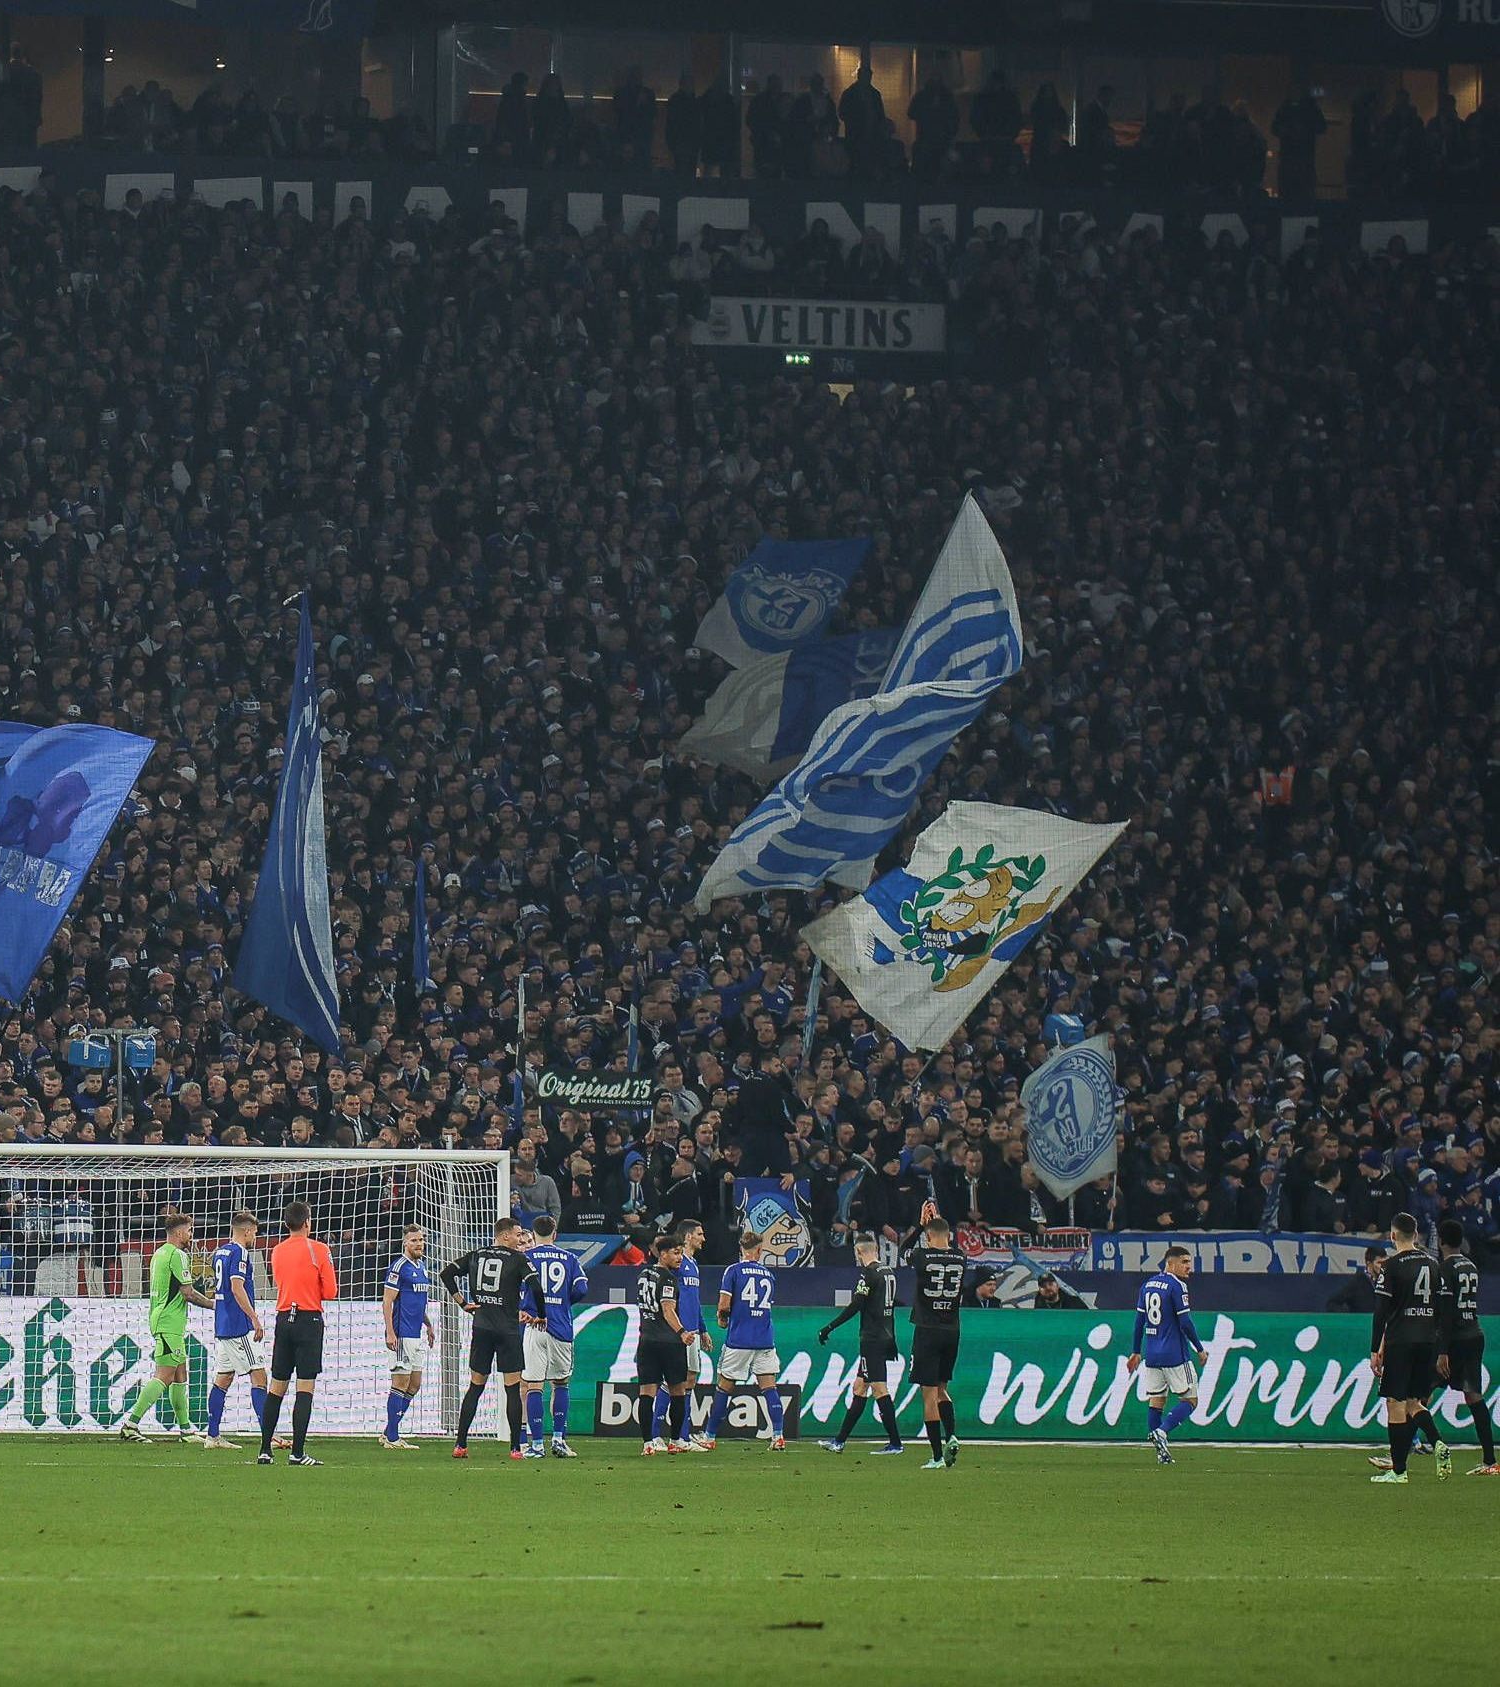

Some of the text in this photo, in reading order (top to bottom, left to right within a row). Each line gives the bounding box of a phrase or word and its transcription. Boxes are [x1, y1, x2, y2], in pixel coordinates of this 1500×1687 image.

[741, 304, 912, 348] VELTINS
[538, 1071, 652, 1104] Original 75
[477, 1257, 503, 1292] 19
[541, 1261, 566, 1293] 19
[923, 1263, 964, 1298] 33
[1414, 1265, 1431, 1304] 4
[741, 1277, 772, 1309] 42
[1145, 1291, 1161, 1325] 18
